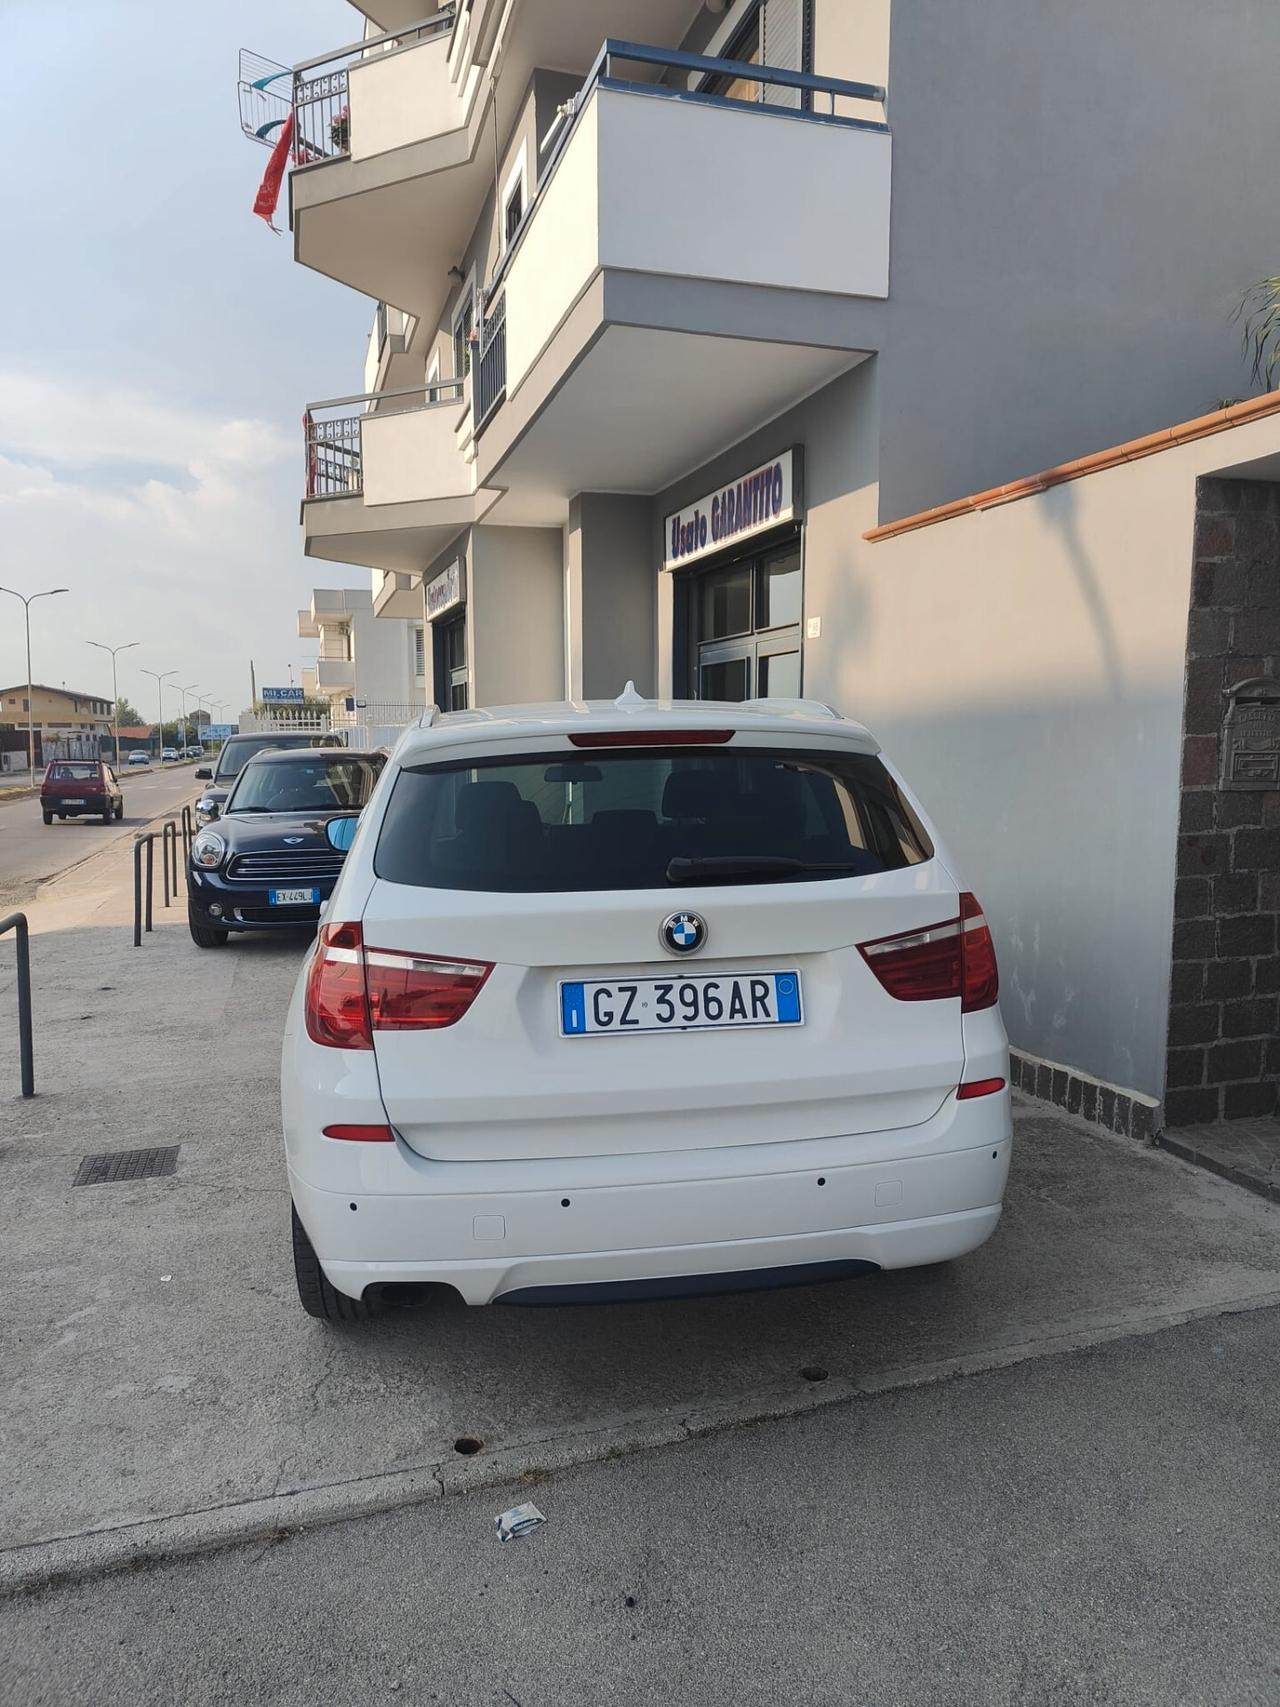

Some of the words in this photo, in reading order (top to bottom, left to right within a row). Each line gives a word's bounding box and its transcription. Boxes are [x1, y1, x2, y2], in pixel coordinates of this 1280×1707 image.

[671, 508, 708, 559] Usato
[711, 462, 783, 544] GARANTITO
[668, 915, 700, 928] BMW
[593, 986, 640, 1027] GZ
[654, 979, 772, 1023] 396AR
